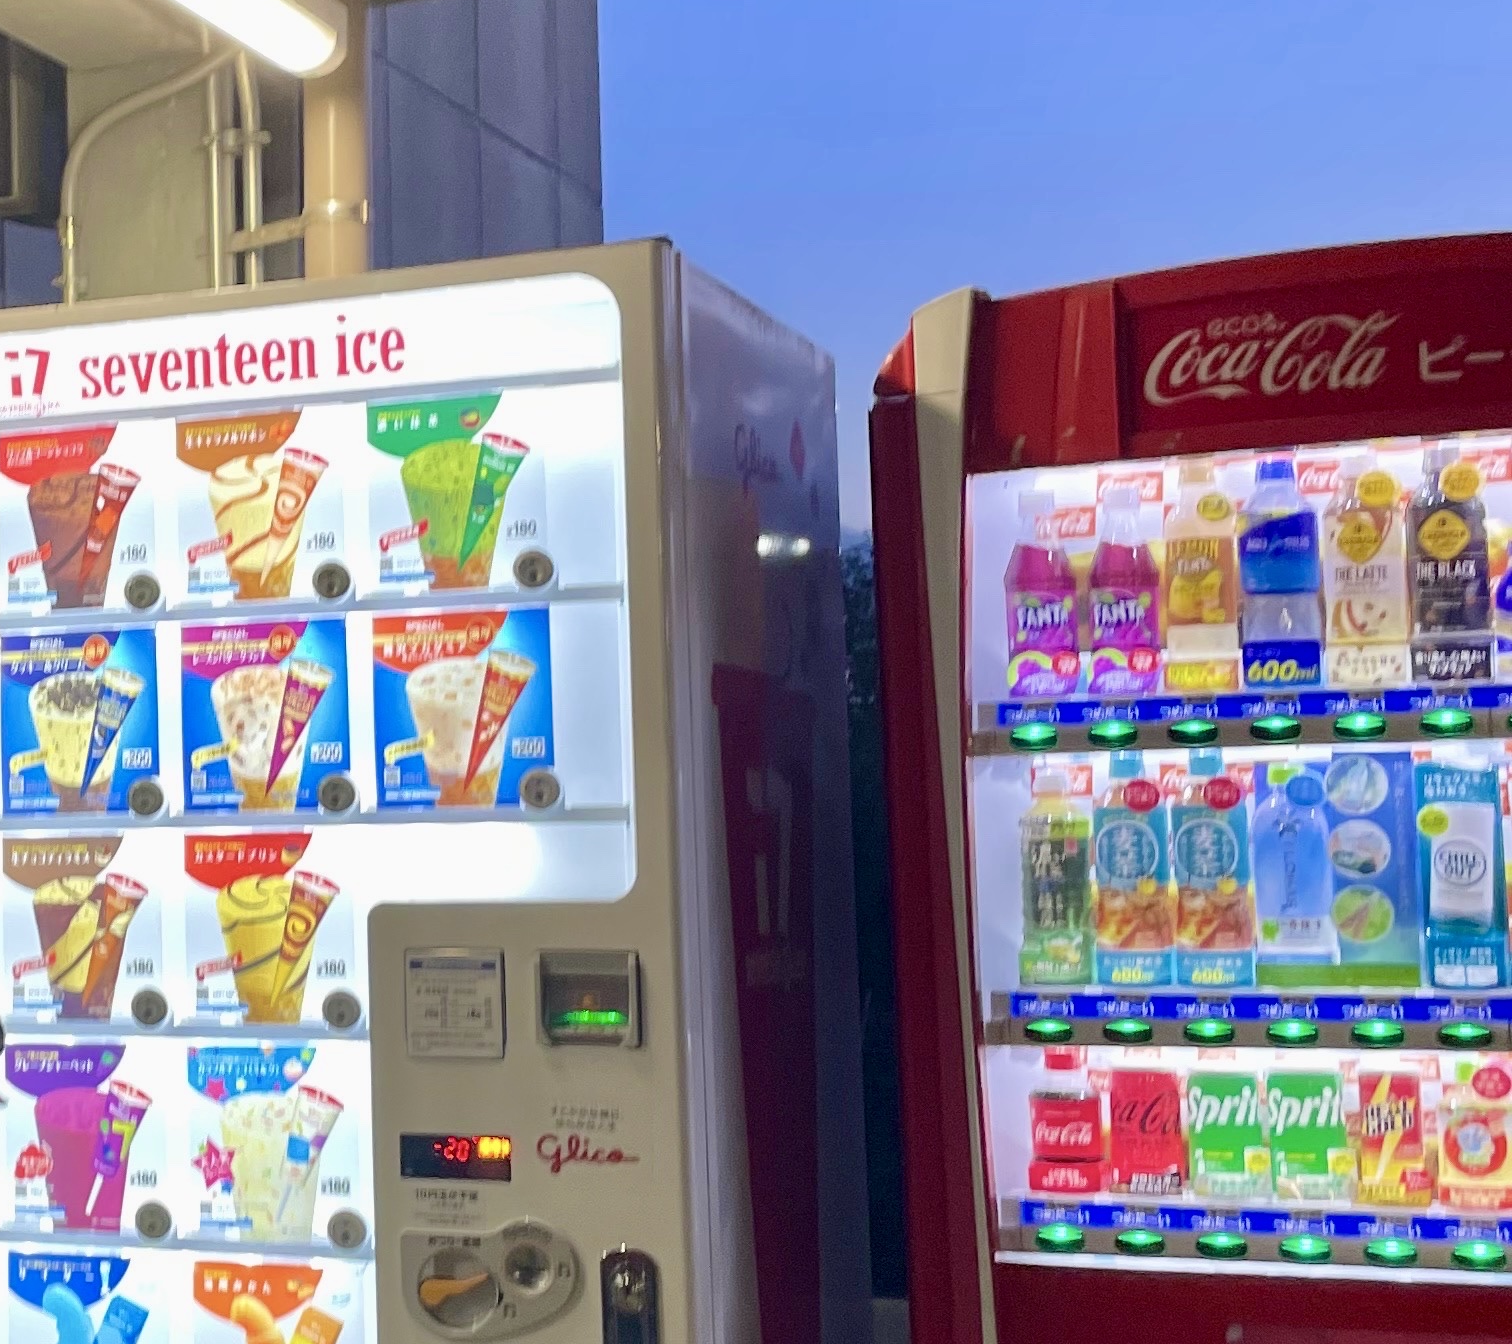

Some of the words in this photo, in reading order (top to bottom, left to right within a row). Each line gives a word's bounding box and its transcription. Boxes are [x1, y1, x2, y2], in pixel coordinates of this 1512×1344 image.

[79, 334, 319, 400] seventeen
[335, 314, 406, 377] ice
[1143, 311, 1404, 406] Coca-Cola
[1247, 658, 1318, 685] 600ml
[537, 1133, 640, 1174] Glico
